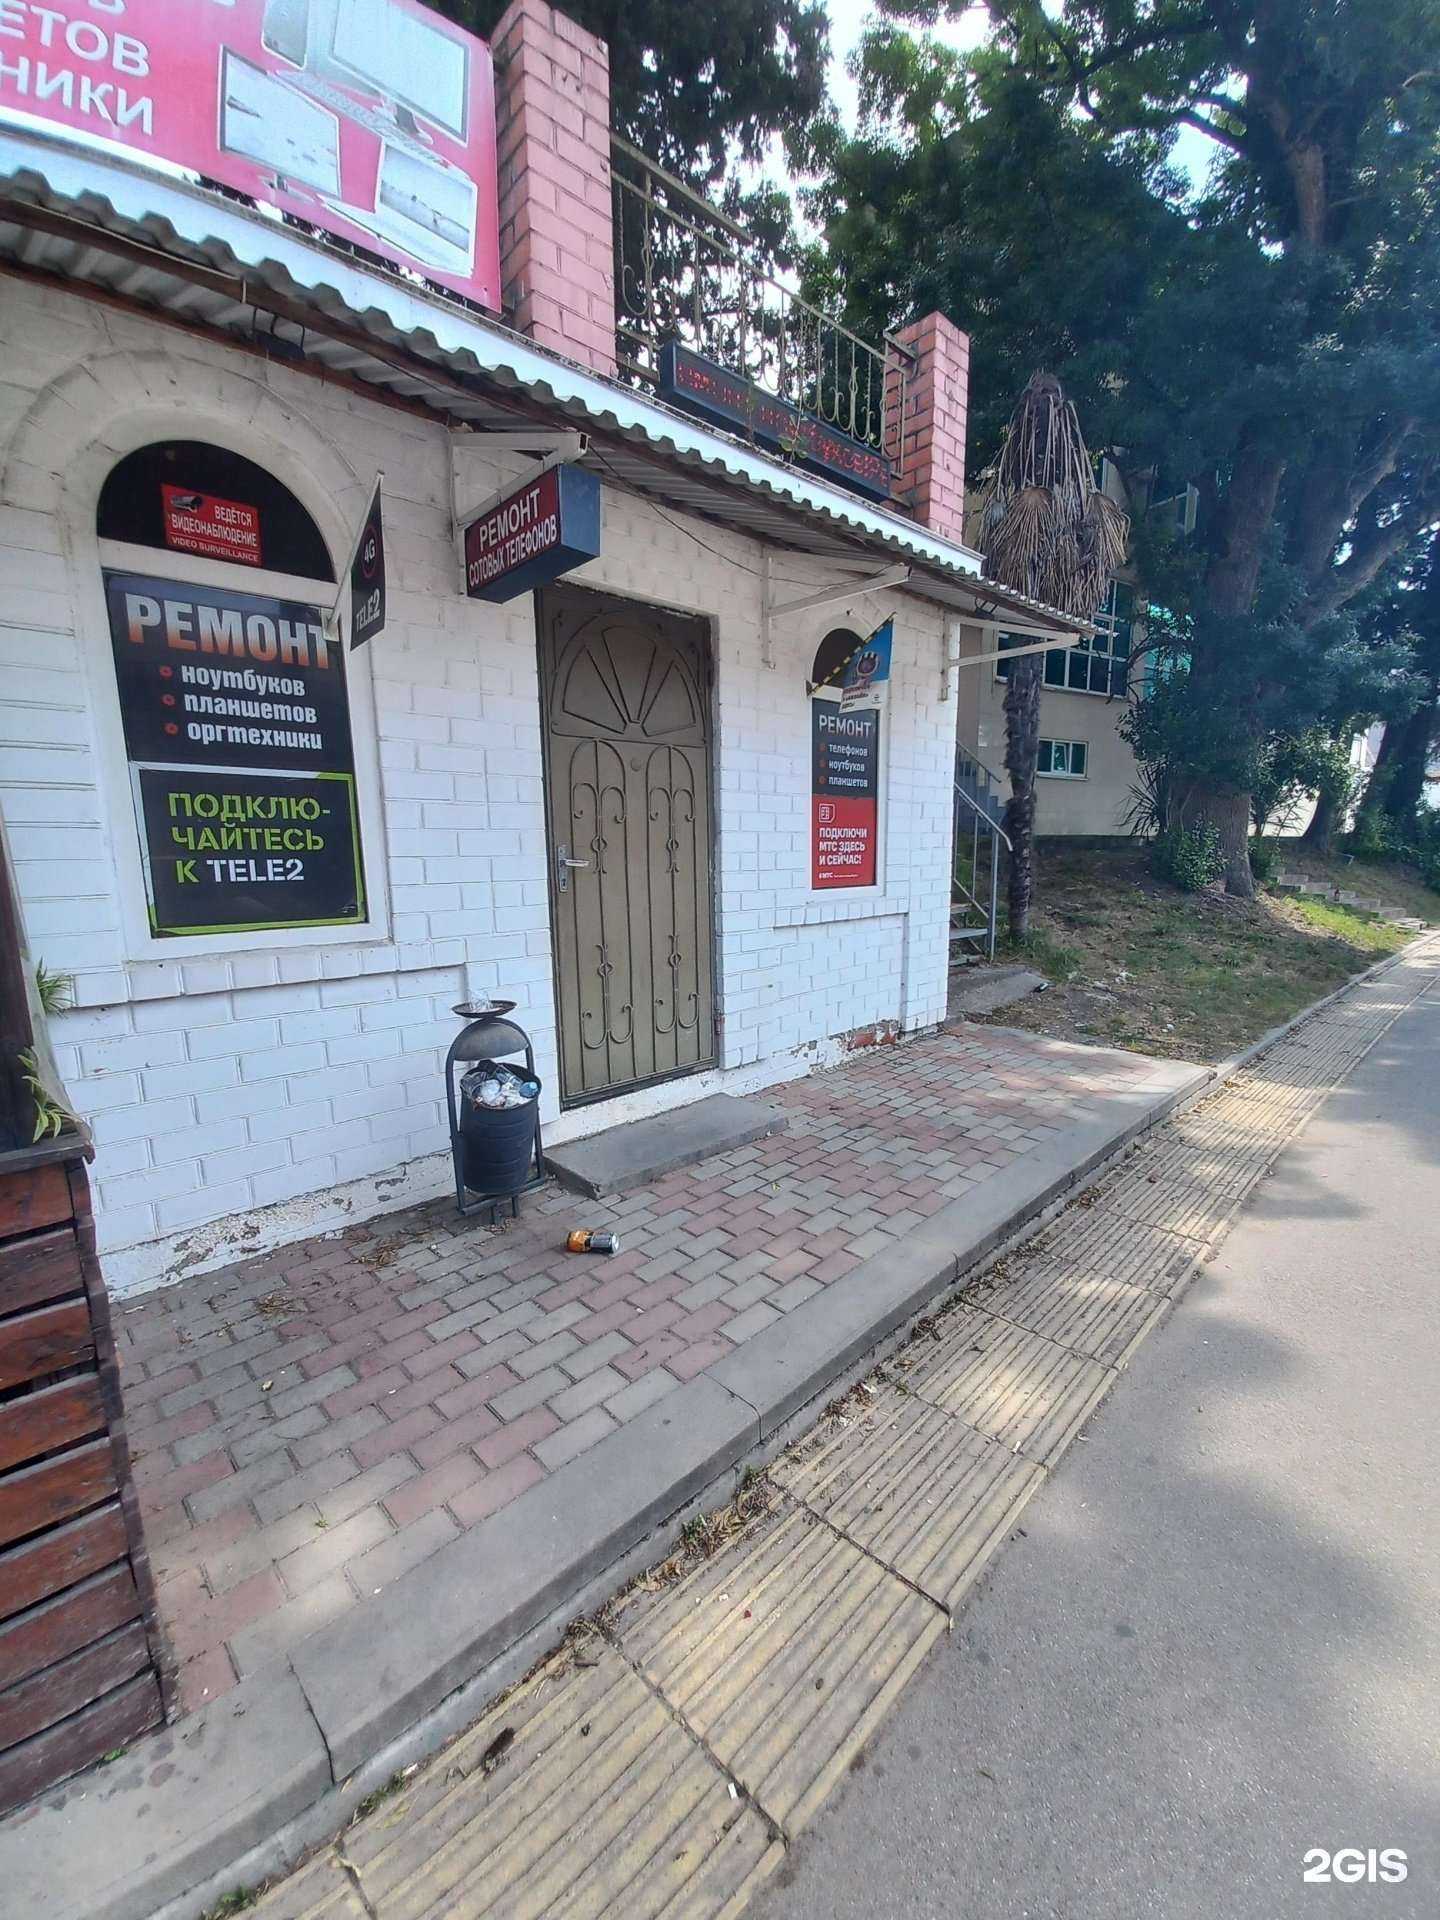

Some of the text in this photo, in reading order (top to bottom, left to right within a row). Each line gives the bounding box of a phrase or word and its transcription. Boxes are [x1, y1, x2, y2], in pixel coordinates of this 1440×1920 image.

[171, 513, 257, 547] ВИДЕОНАБЛЮДЕНИЕ
[479, 488, 541, 551] РЕМОНТ
[171, 536, 259, 562] VIDEO SURVEILLANCE
[469, 514, 557, 587] СОТОВЫХ ТЕЛЕФОНОВ
[124, 592, 329, 669] РЕМОНТ
[181, 665, 306, 698] ноутбуков
[184, 693, 318, 724] планшетов
[187, 723, 323, 750] оргтехники
[818, 714, 872, 737] РЕМОНТ
[828, 743, 868, 757] телефонов
[828, 760, 865, 773] ноутбуков
[828, 776, 868, 788] планшетов
[168, 792, 332, 823] ПОДКЛЮ-
[171, 821, 325, 850] ЧАЙТЕСЬ
[819, 828, 867, 840] ПОДКЛЮЧИ
[819, 842, 866, 853] МТС ЗДЕСЬ
[819, 852, 862, 865] И СЕЙЧАС!
[175, 858, 305, 883] К TELE2
